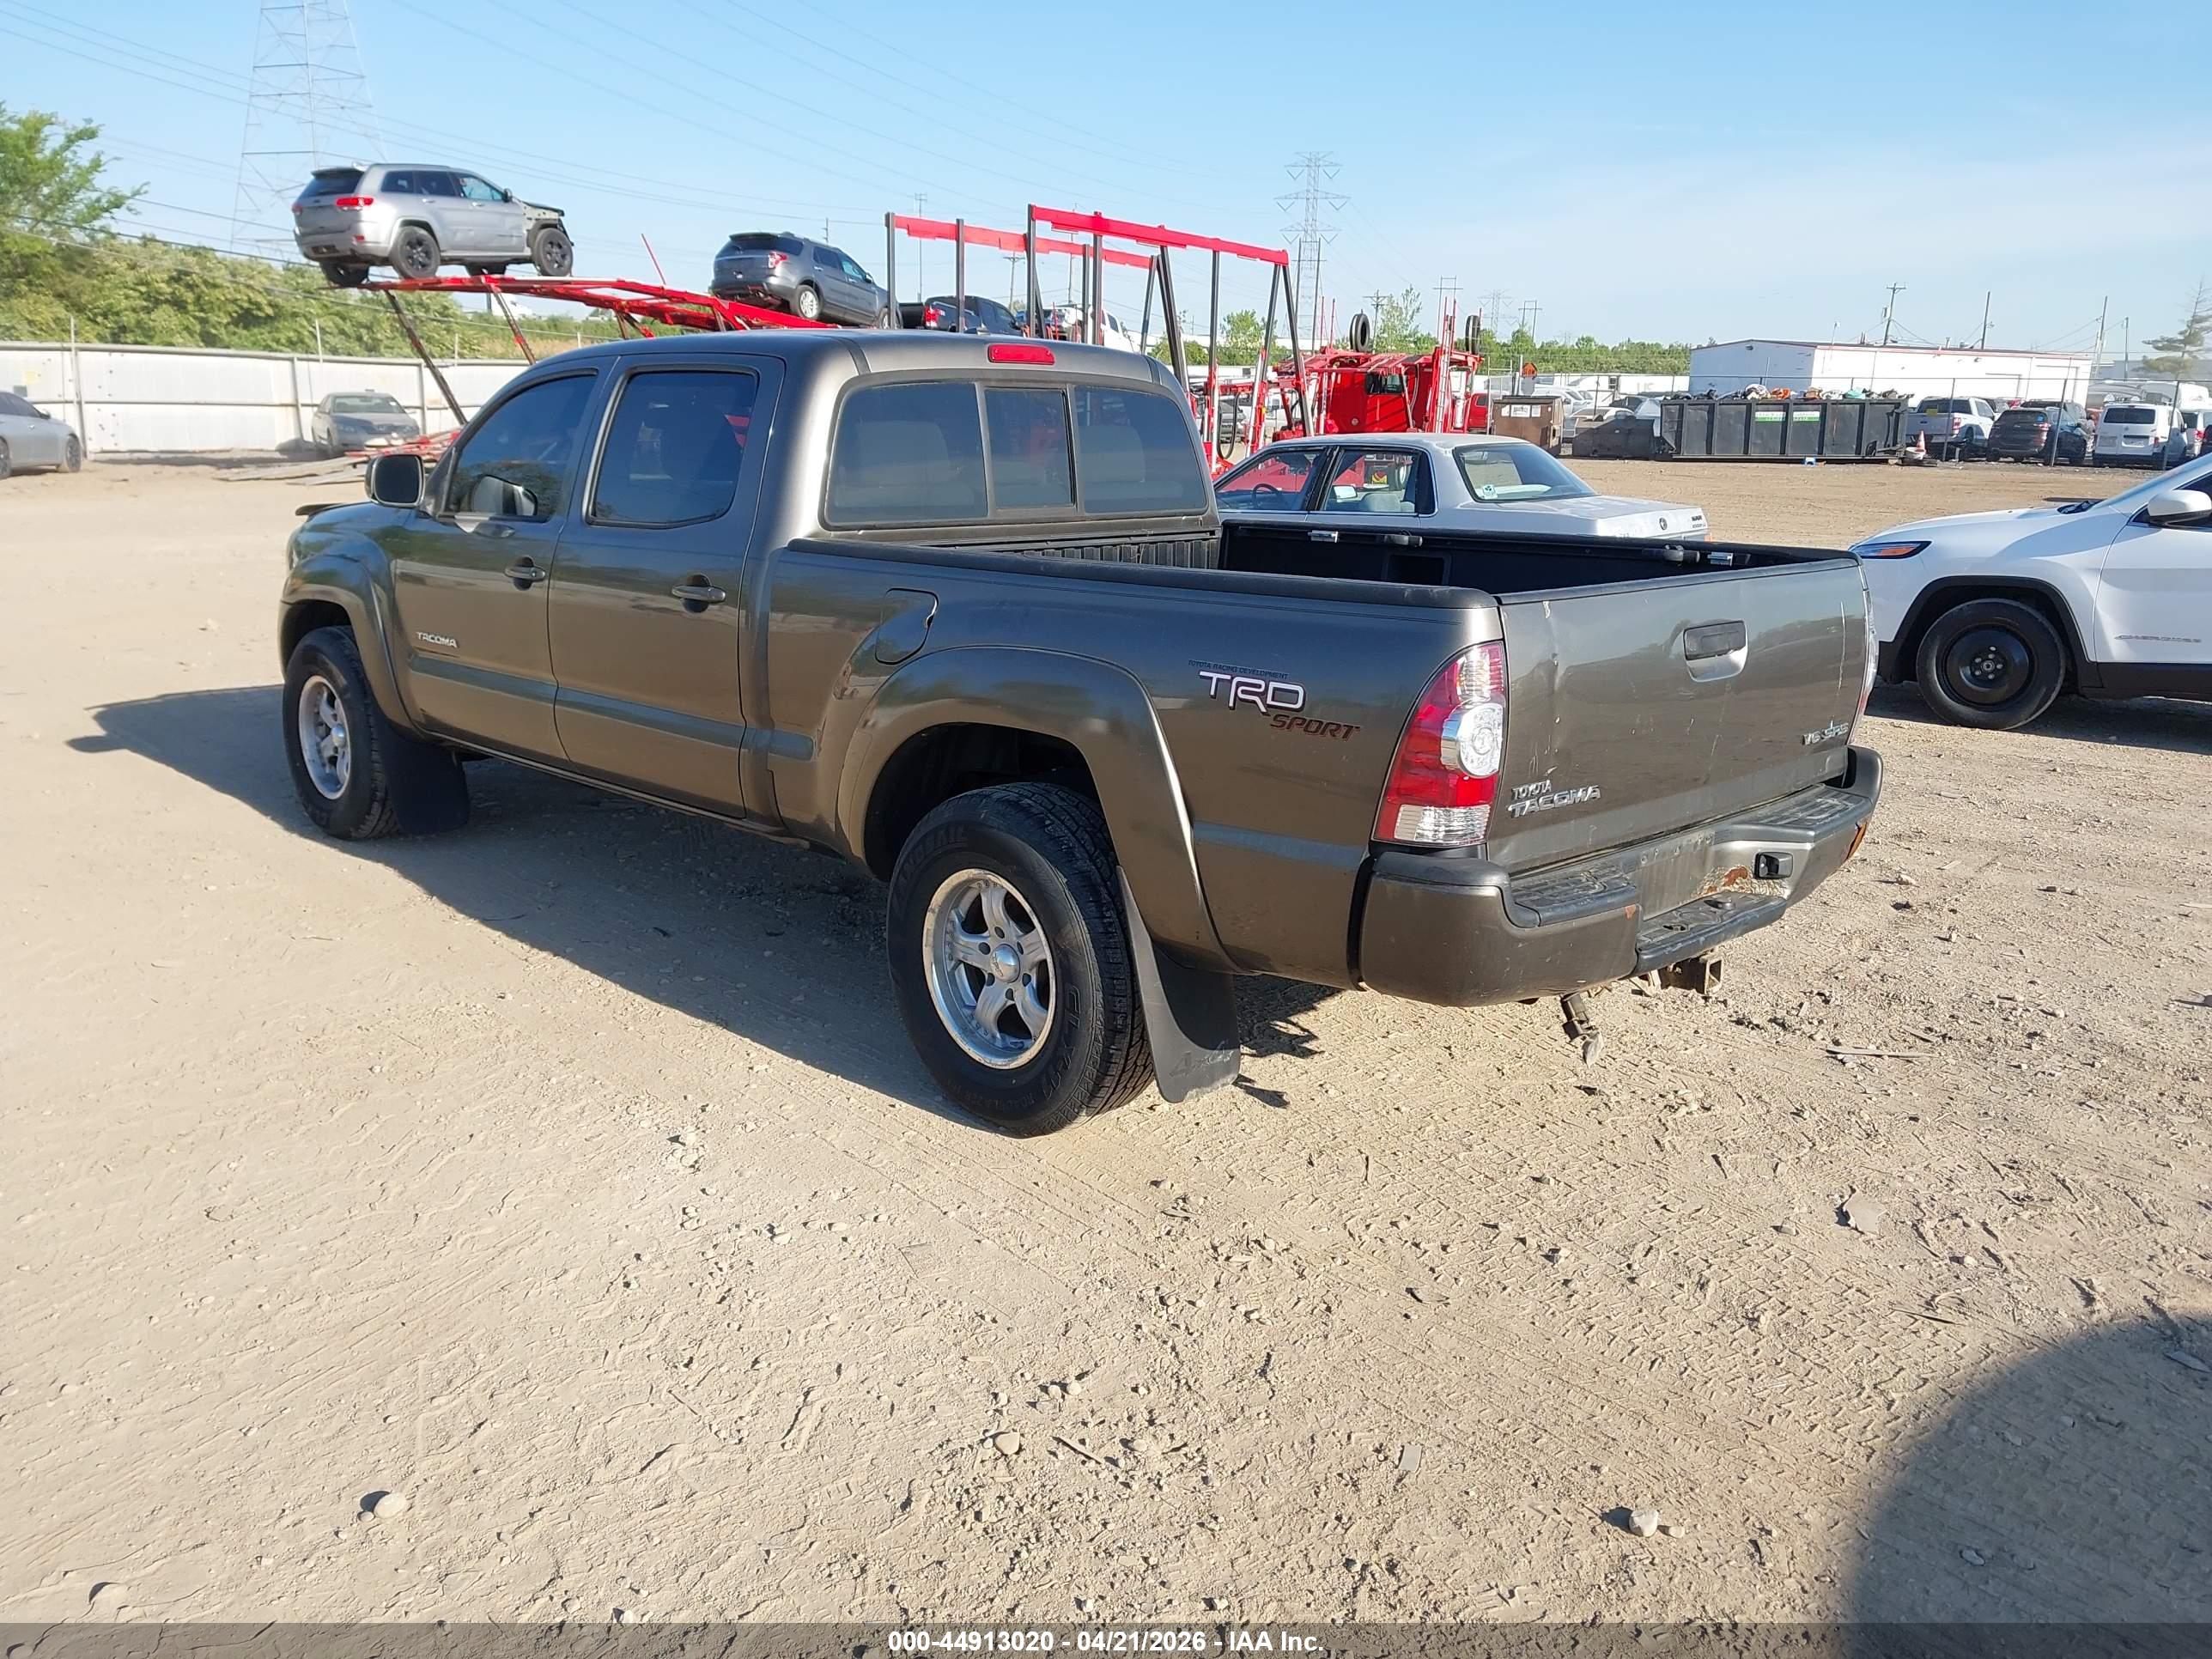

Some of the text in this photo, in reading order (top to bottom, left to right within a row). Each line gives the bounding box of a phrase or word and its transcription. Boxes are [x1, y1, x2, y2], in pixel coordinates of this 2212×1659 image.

[416, 631, 458, 648] TACOMA
[1188, 659, 1289, 680] TOYOTA RACING DEVELOPMENT
[1199, 670, 1306, 717] TRD
[1269, 714, 1361, 742] SPORT
[1507, 785, 1601, 818] TACOMA
[1511, 779, 1552, 800] TOYOTA
